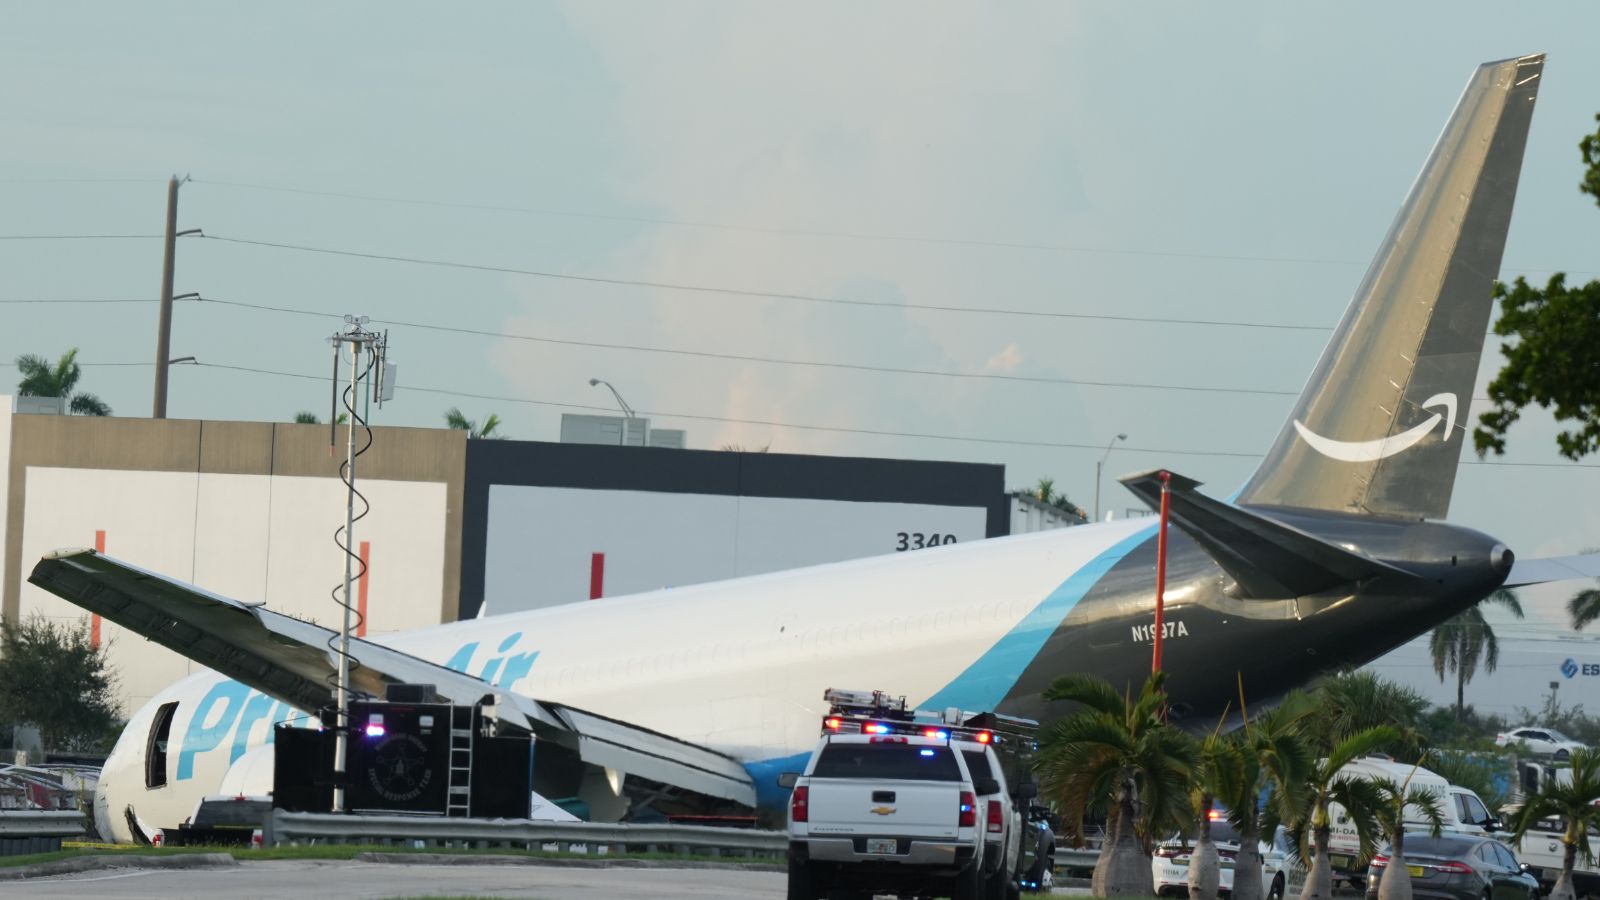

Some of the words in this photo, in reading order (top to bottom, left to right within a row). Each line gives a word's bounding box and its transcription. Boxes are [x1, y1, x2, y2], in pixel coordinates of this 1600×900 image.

[896, 532, 957, 552] 3340
[1131, 620, 1189, 642] N1997A
[418, 768, 433, 788] TEAM
